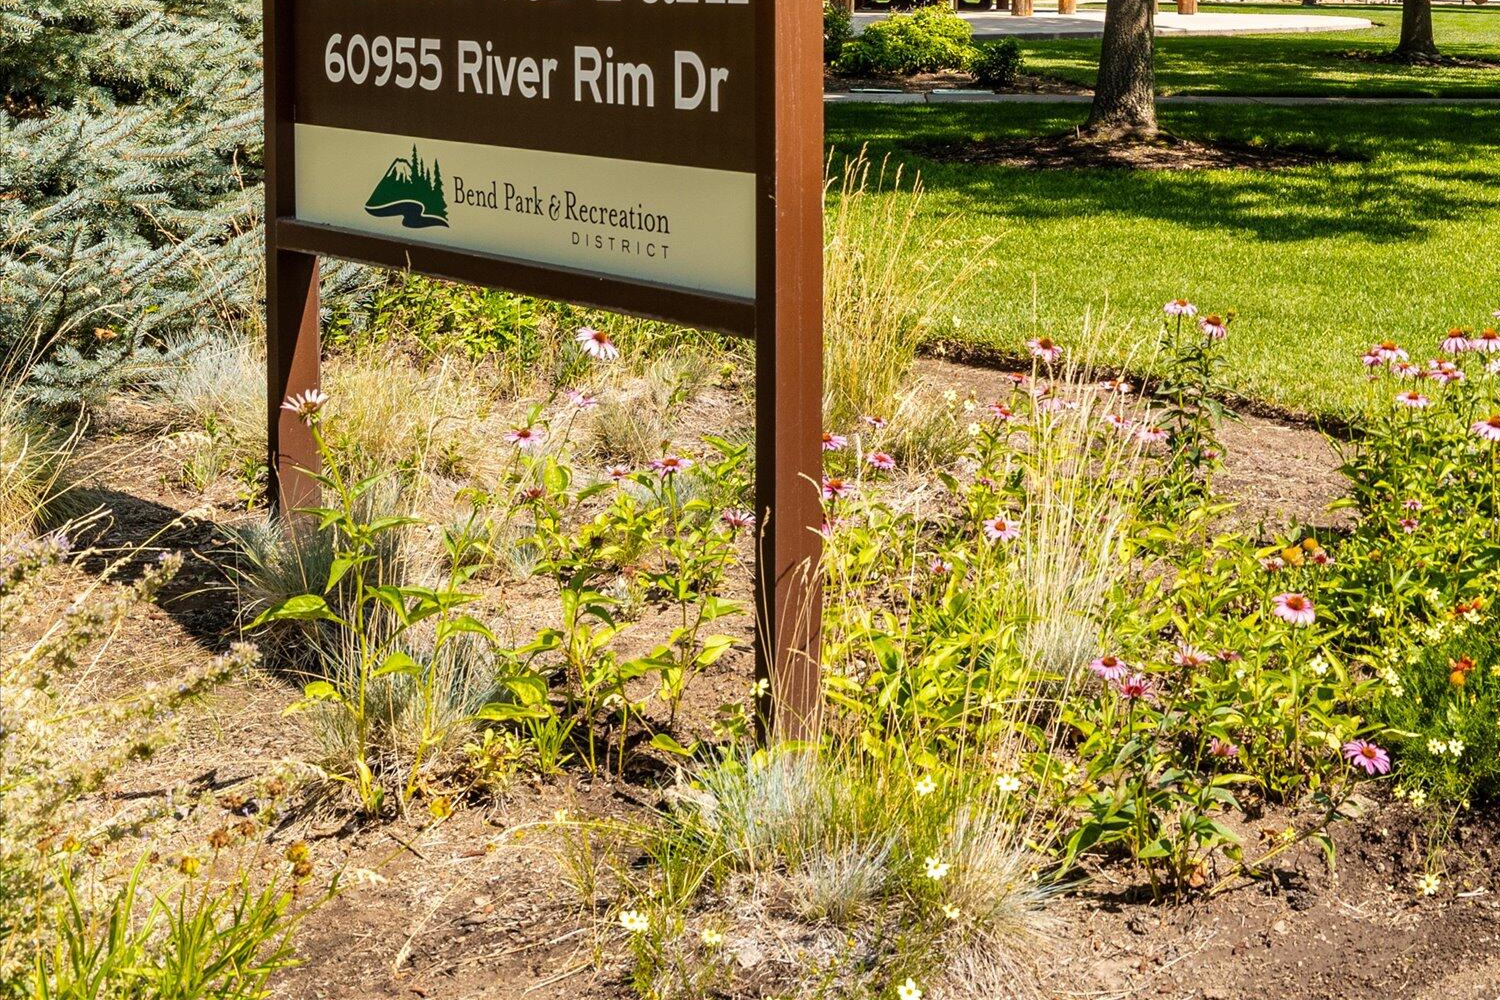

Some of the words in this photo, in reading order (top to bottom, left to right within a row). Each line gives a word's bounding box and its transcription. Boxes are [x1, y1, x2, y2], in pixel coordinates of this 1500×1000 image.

[324, 33, 443, 92] 60955
[457, 40, 558, 99] River
[574, 45, 655, 108] Rim
[674, 49, 729, 113] Dr
[453, 175, 499, 210] Bend
[503, 183, 545, 217] Park
[549, 194, 562, 221] &
[564, 190, 670, 234] Recreation
[572, 232, 669, 259] DISTRICT
